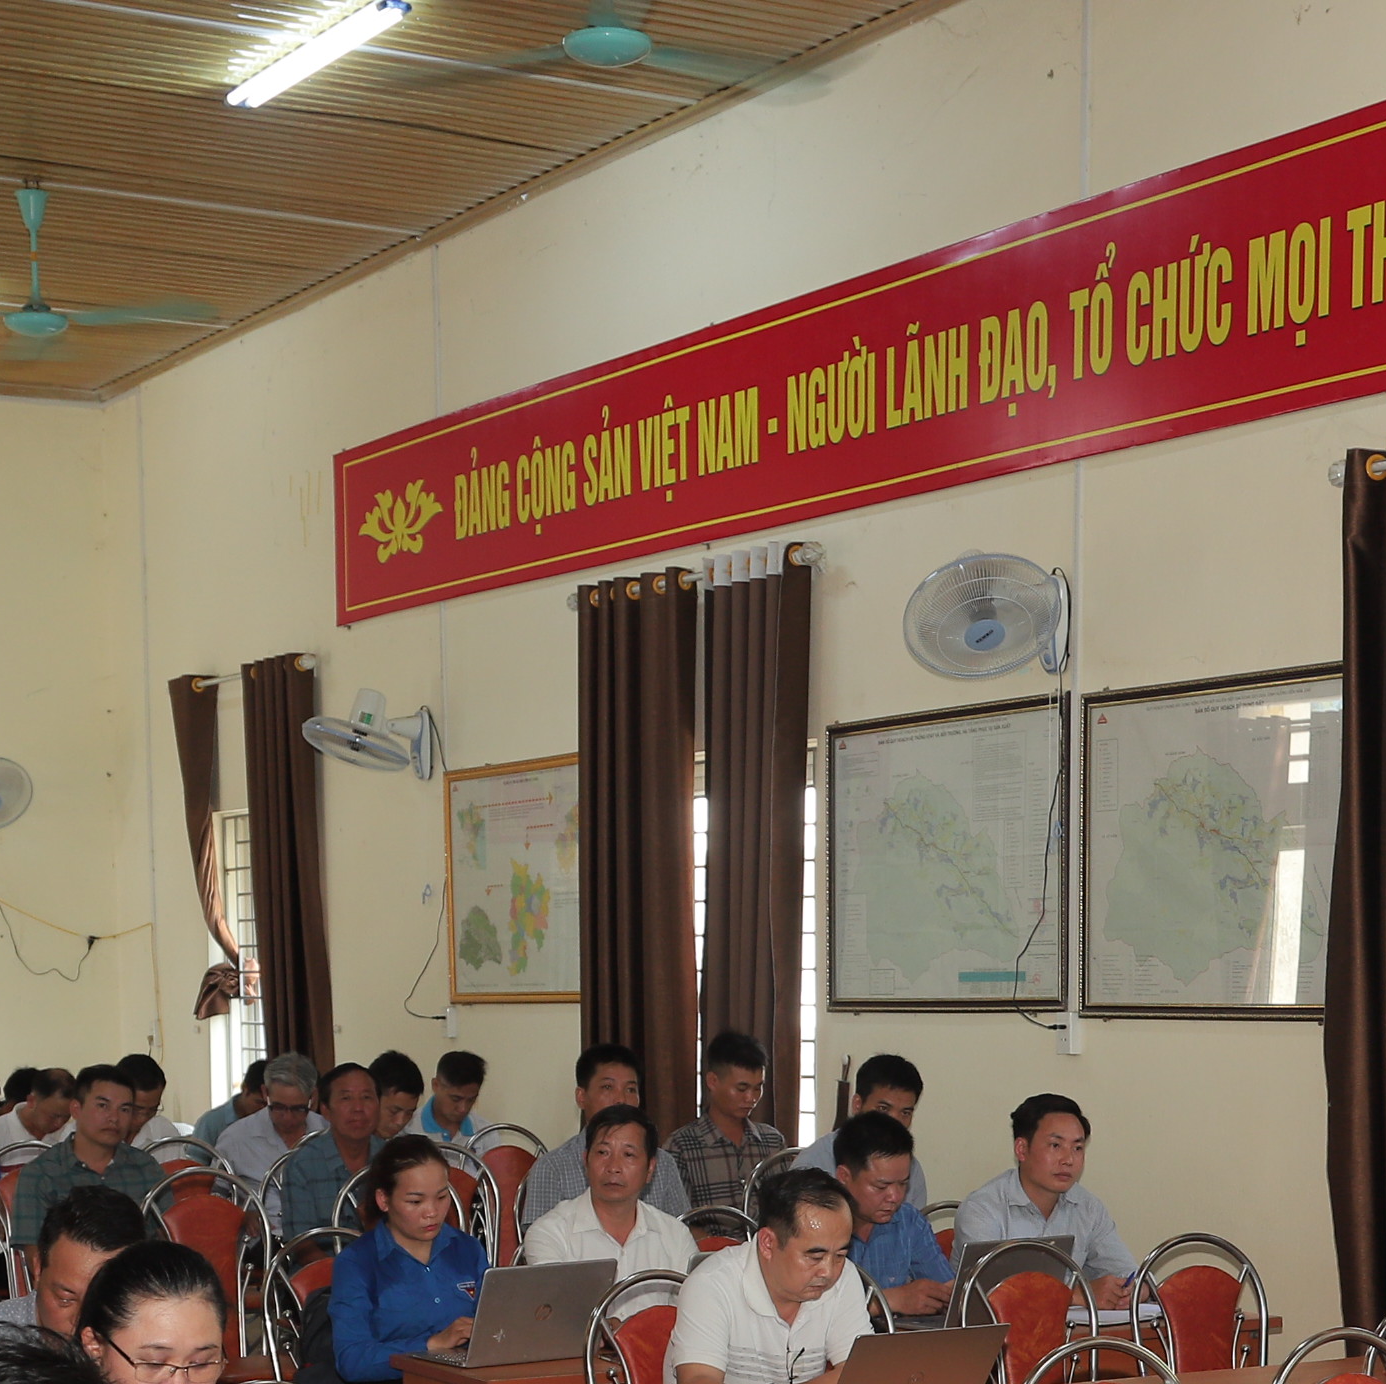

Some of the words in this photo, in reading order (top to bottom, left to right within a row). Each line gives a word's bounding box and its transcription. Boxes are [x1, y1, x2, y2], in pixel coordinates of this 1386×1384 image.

[454, 446, 510, 540] ĐẢNG
[516, 436, 576, 535] CỘNG
[582, 405, 631, 507] SẢN
[638, 395, 690, 502] VIỆT
[697, 386, 758, 477] NAM
[787, 336, 875, 454] NGƯỜI
[886, 321, 968, 429] LÃNH
[979, 301, 1057, 417] ĐẠO,
[1069, 242, 1116, 380] TỔ
[1126, 234, 1232, 366] CHỨC
[1247, 216, 1331, 347] MỌI
